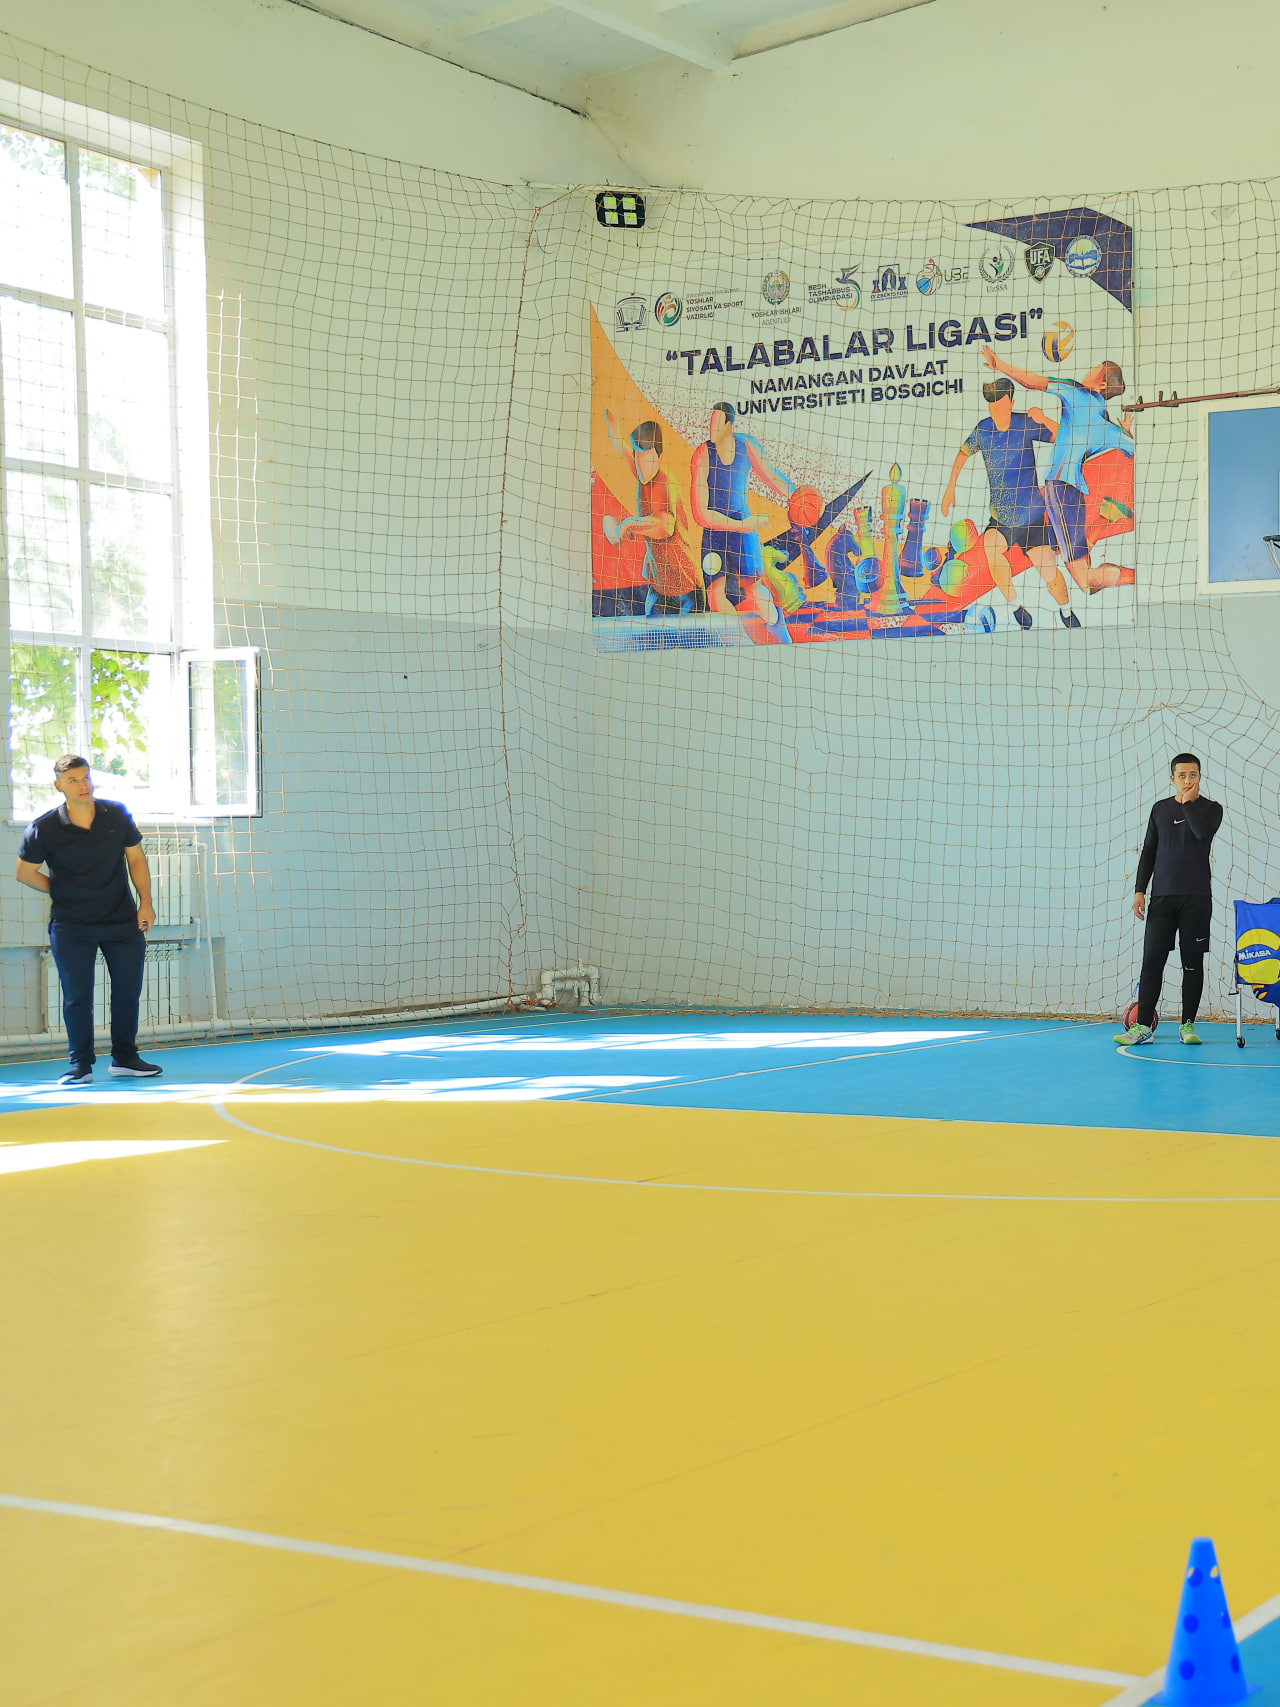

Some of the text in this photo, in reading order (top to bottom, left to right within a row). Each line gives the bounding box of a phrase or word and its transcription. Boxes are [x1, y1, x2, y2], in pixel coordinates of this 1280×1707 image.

[808, 287, 851, 297] TASHABBUS
[686, 296, 714, 306] YOSHLAR
[723, 300, 744, 309] SPORT
[750, 360, 949, 395] NAMANGAN DAVLAT
[736, 378, 963, 416] UNIVERSITETI BOSQICHI
